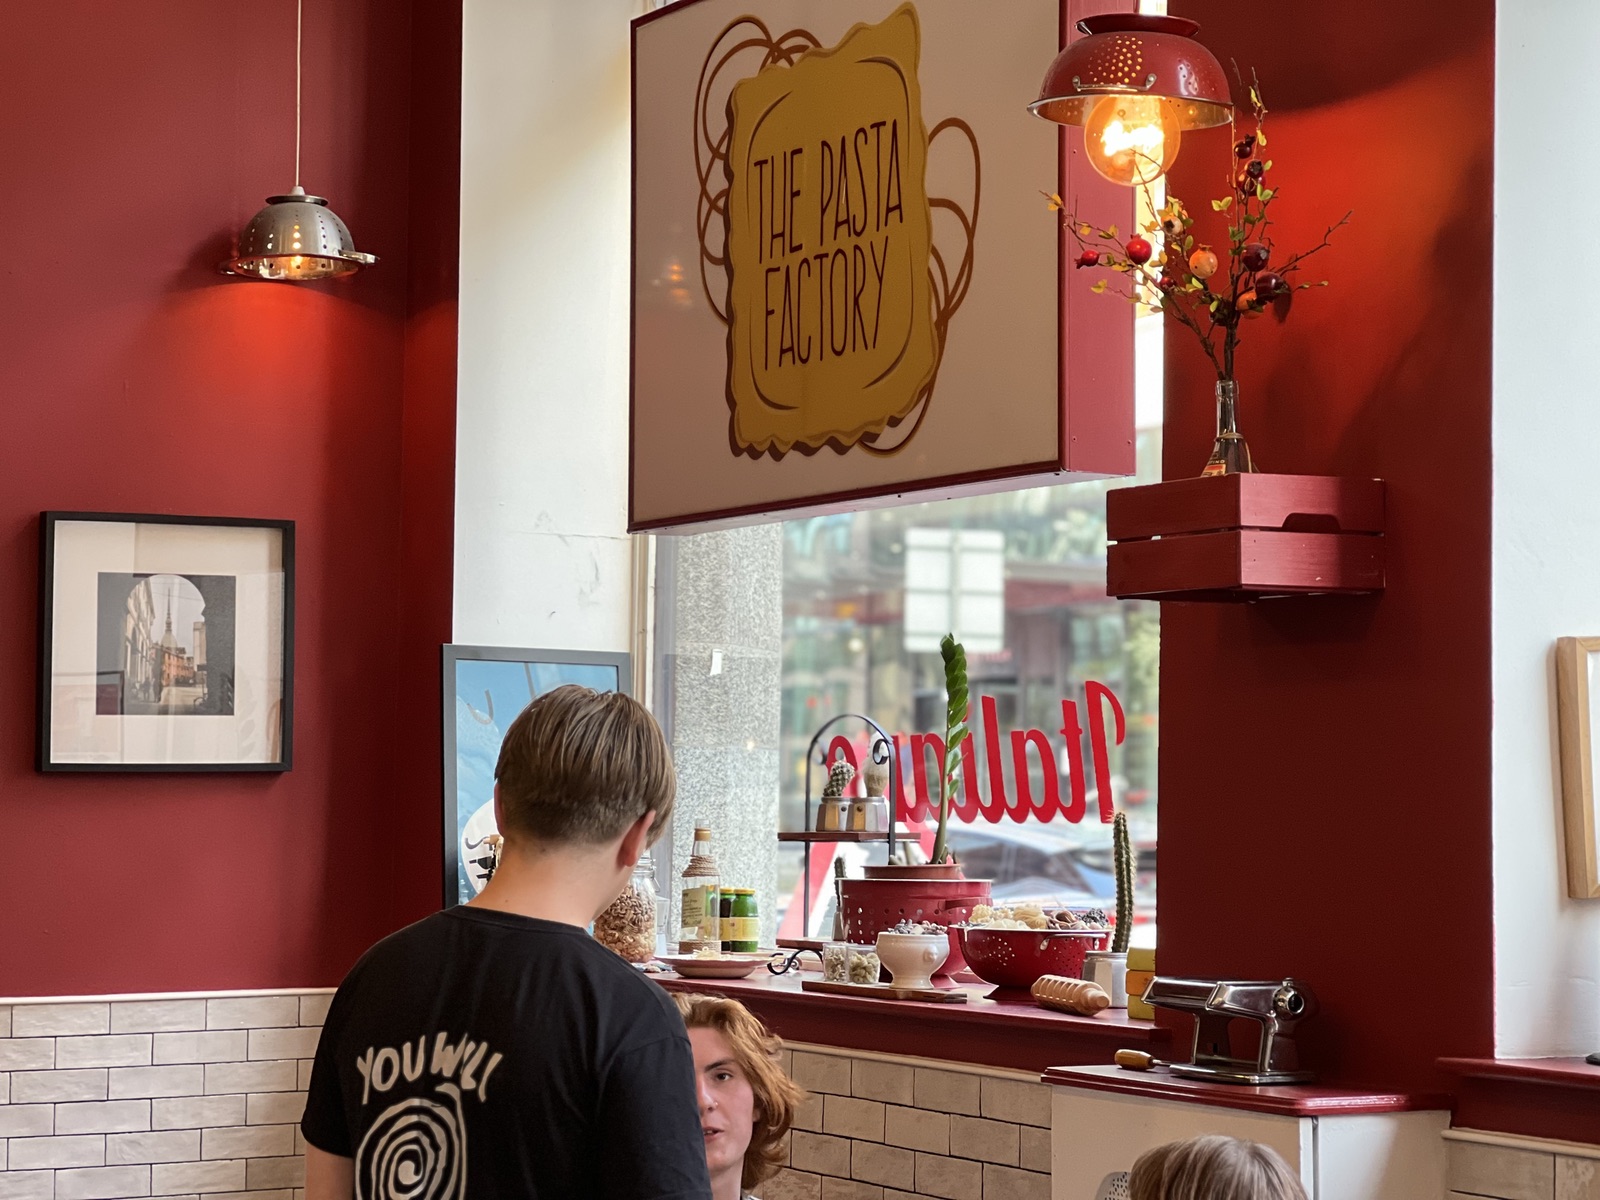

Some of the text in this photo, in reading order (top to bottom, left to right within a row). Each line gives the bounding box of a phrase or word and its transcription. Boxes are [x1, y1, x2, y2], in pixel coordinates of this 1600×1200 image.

[753, 118, 903, 264] THE PASTA
[764, 235, 889, 371] FACTORY
[356, 1035, 426, 1105] YOU
